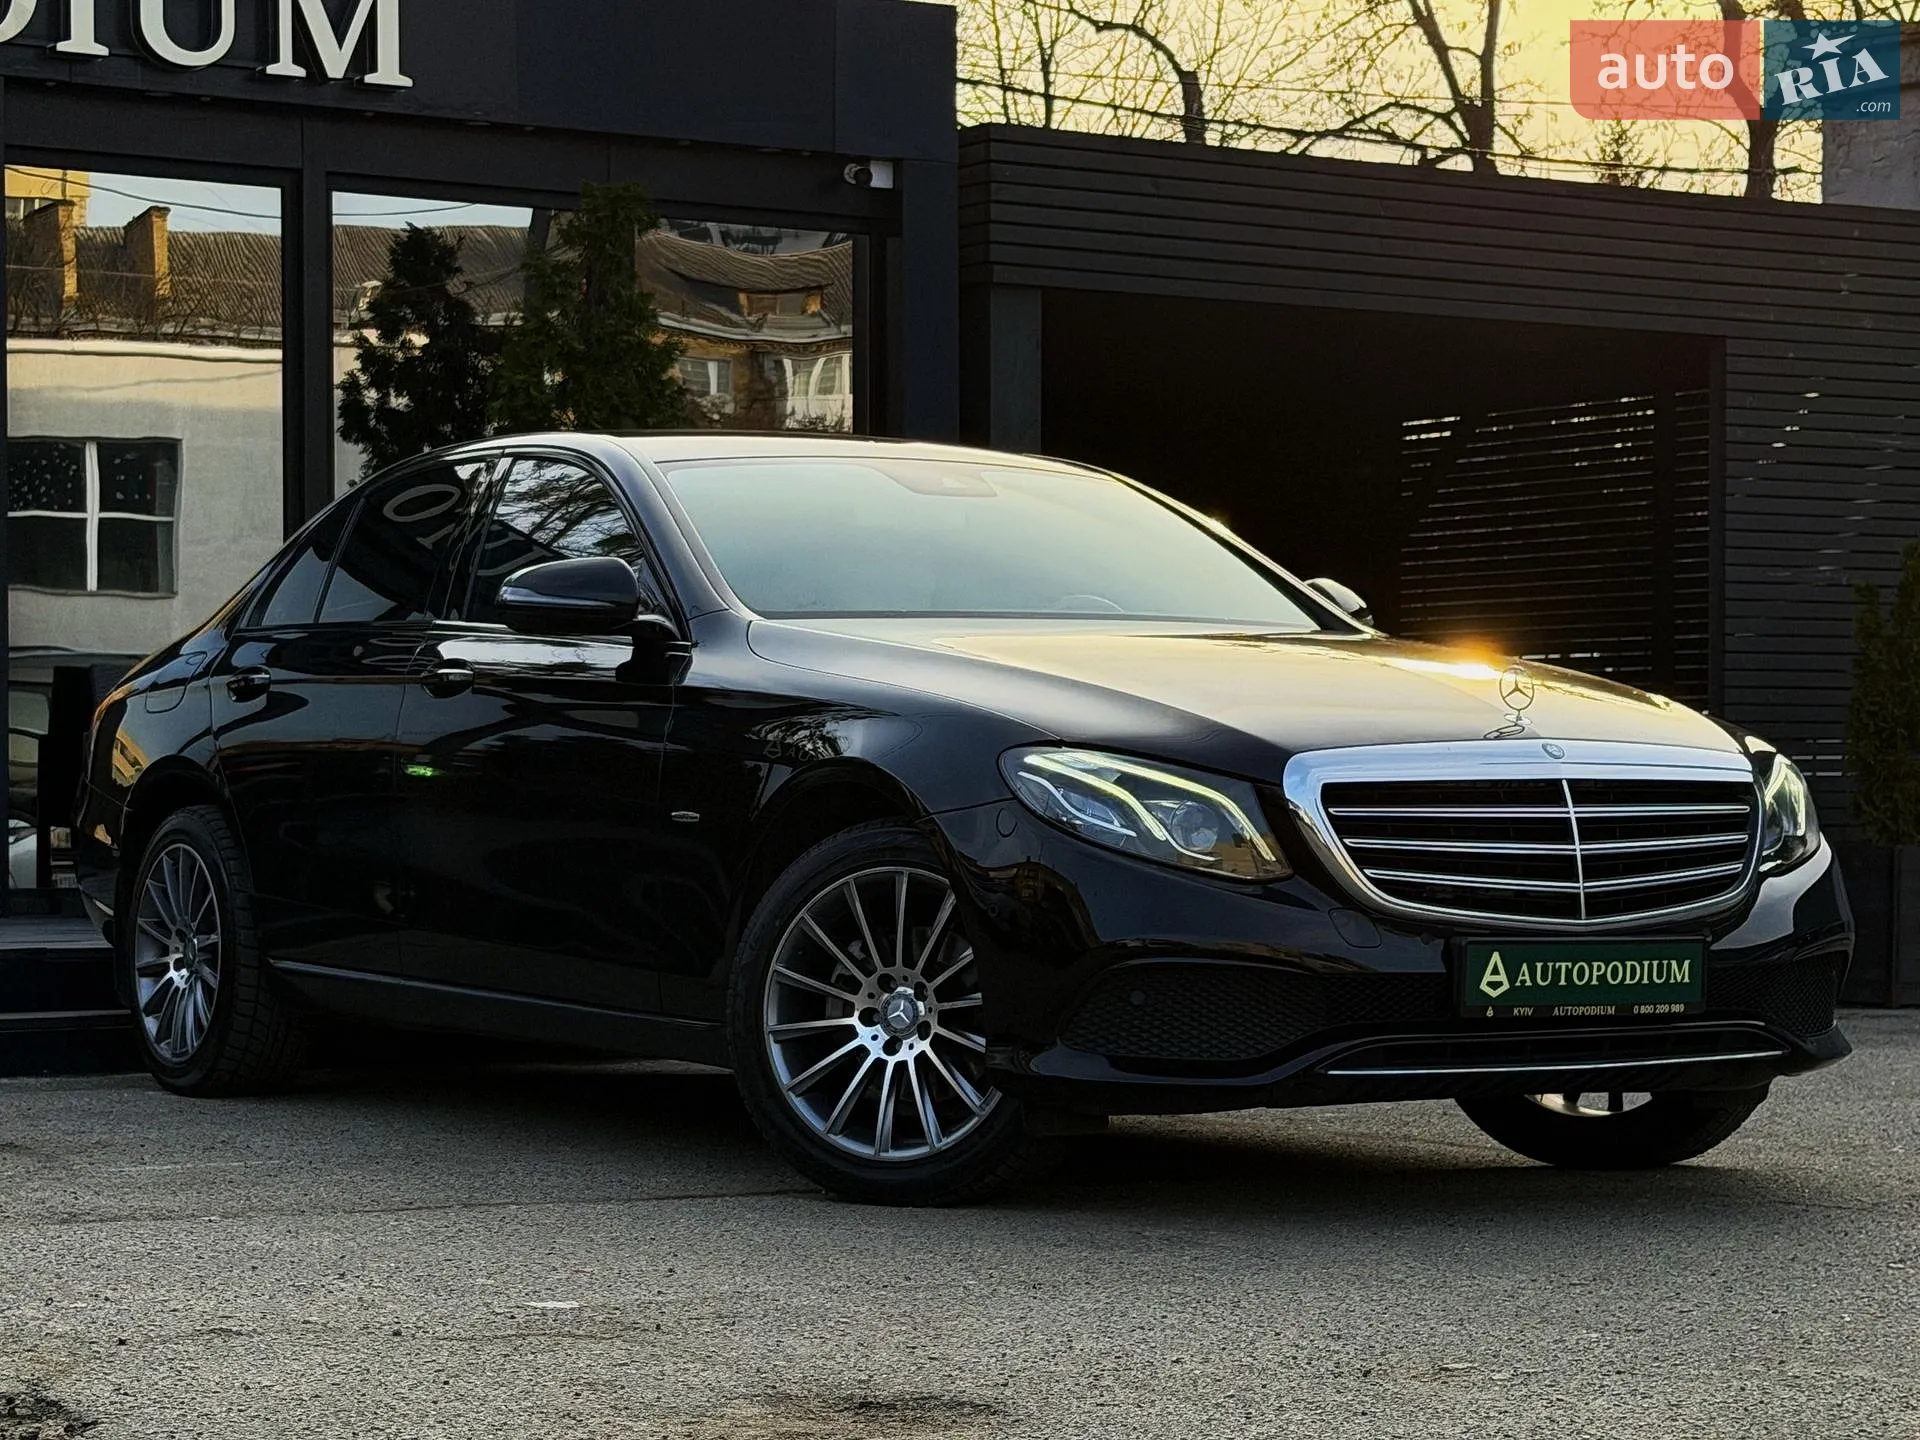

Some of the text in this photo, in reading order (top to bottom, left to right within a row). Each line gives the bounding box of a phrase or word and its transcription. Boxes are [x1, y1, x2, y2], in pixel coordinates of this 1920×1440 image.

[1514, 959, 1691, 987] AUTOPODIUM
[1513, 1007, 1534, 1017] KYIV
[1552, 1005, 1616, 1016] AUTOPODIUM
